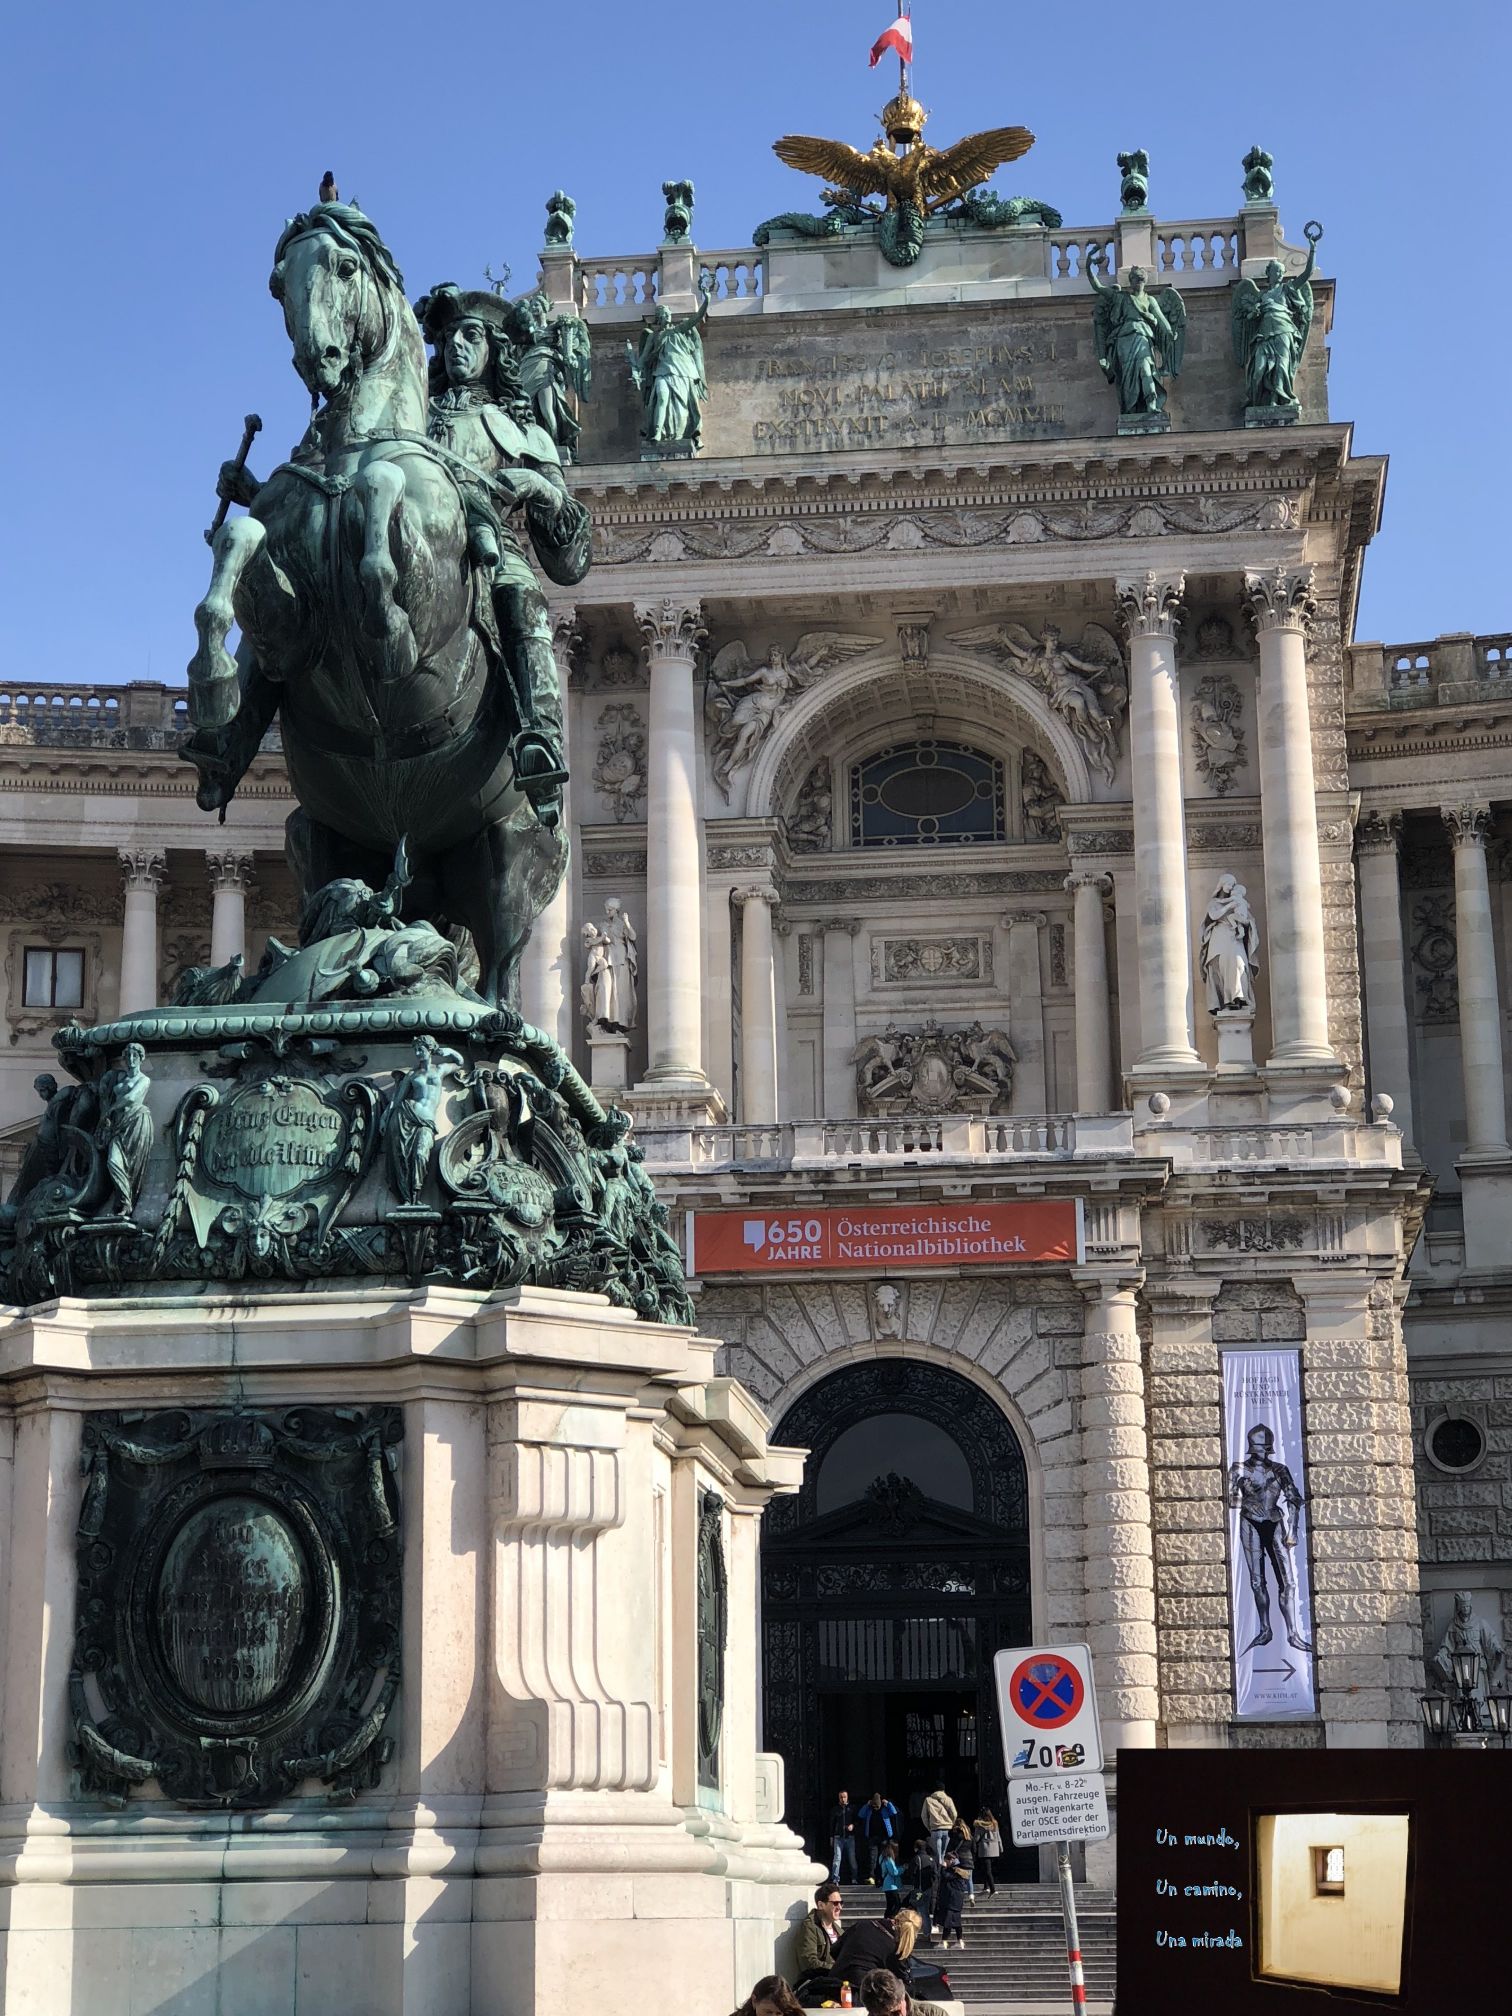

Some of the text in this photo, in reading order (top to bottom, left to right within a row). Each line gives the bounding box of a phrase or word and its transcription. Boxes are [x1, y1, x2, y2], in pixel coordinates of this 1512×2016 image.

[780, 386, 841, 408] NOVI
[273, 1104, 340, 1133] Eugen
[768, 1219, 822, 1244] 650
[838, 1216, 991, 1237] Österreichische
[767, 1245, 822, 1260] JAHRE
[838, 1236, 1027, 1258] Nationalbibliothek
[1016, 1791, 1100, 1805] ausgen. Fahrzeuge
[1024, 1803, 1094, 1816] mit Wagenkarte
[1021, 1813, 1099, 1828] der OSCE oder der
[1016, 1824, 1107, 1840] Parlamentsdirektion
